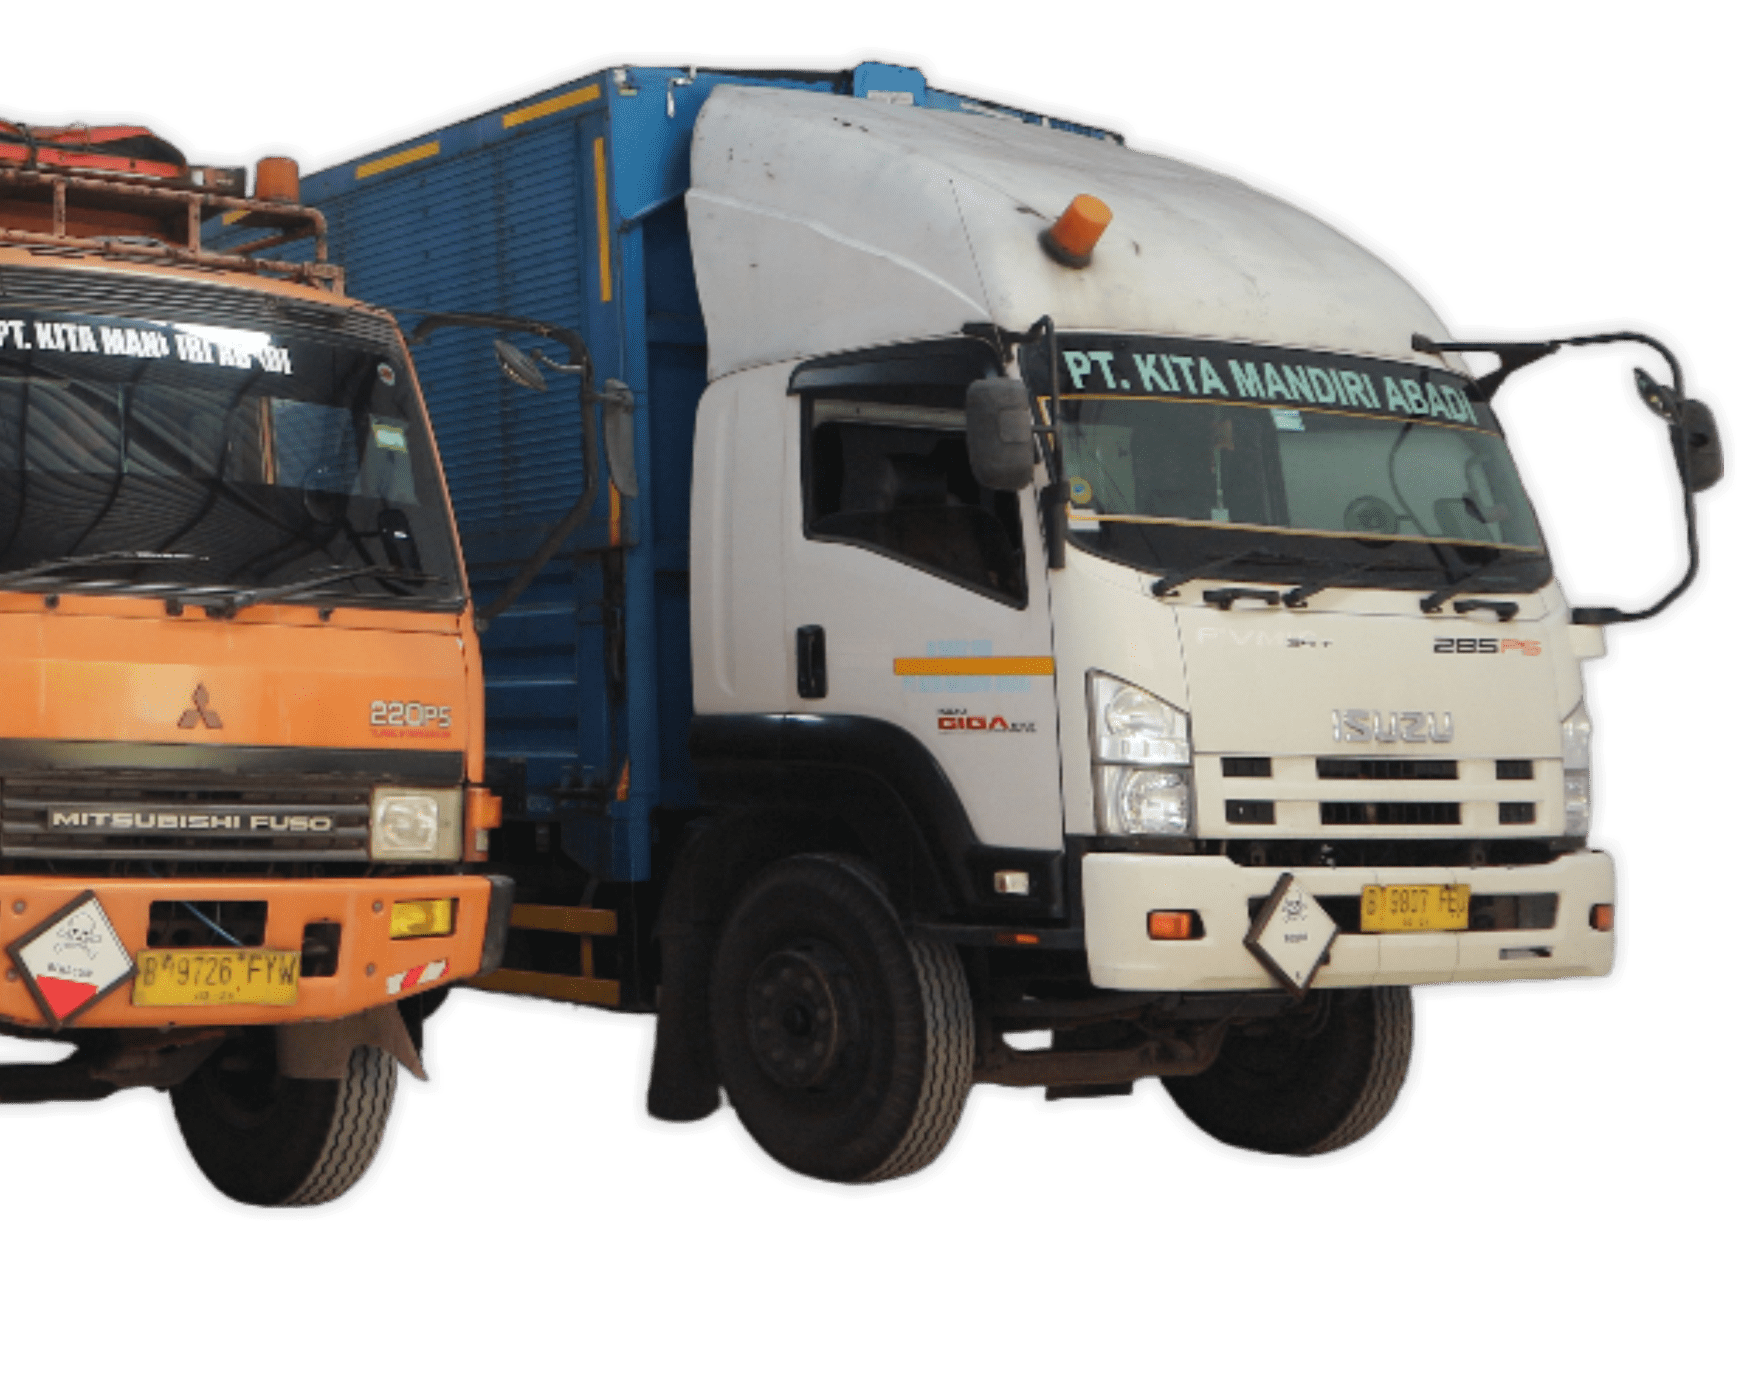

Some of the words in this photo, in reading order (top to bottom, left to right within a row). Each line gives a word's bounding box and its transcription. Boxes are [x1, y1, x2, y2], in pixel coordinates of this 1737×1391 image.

[34, 321, 99, 353] KITA
[1062, 350, 1131, 389] PT.
[1133, 353, 1229, 397] KITA
[1227, 359, 1381, 409] MANDIRI
[1383, 376, 1480, 425] ABADI
[370, 700, 452, 728] 220PS
[937, 714, 1010, 731] GIGA
[1331, 708, 1453, 744] ISUZU
[52, 812, 241, 829] MITSUBISHI
[250, 815, 332, 832] FUSO
[1366, 888, 1377, 916] B
[143, 955, 158, 987] B
[175, 956, 233, 987] 9726
[245, 951, 298, 986] FYW
